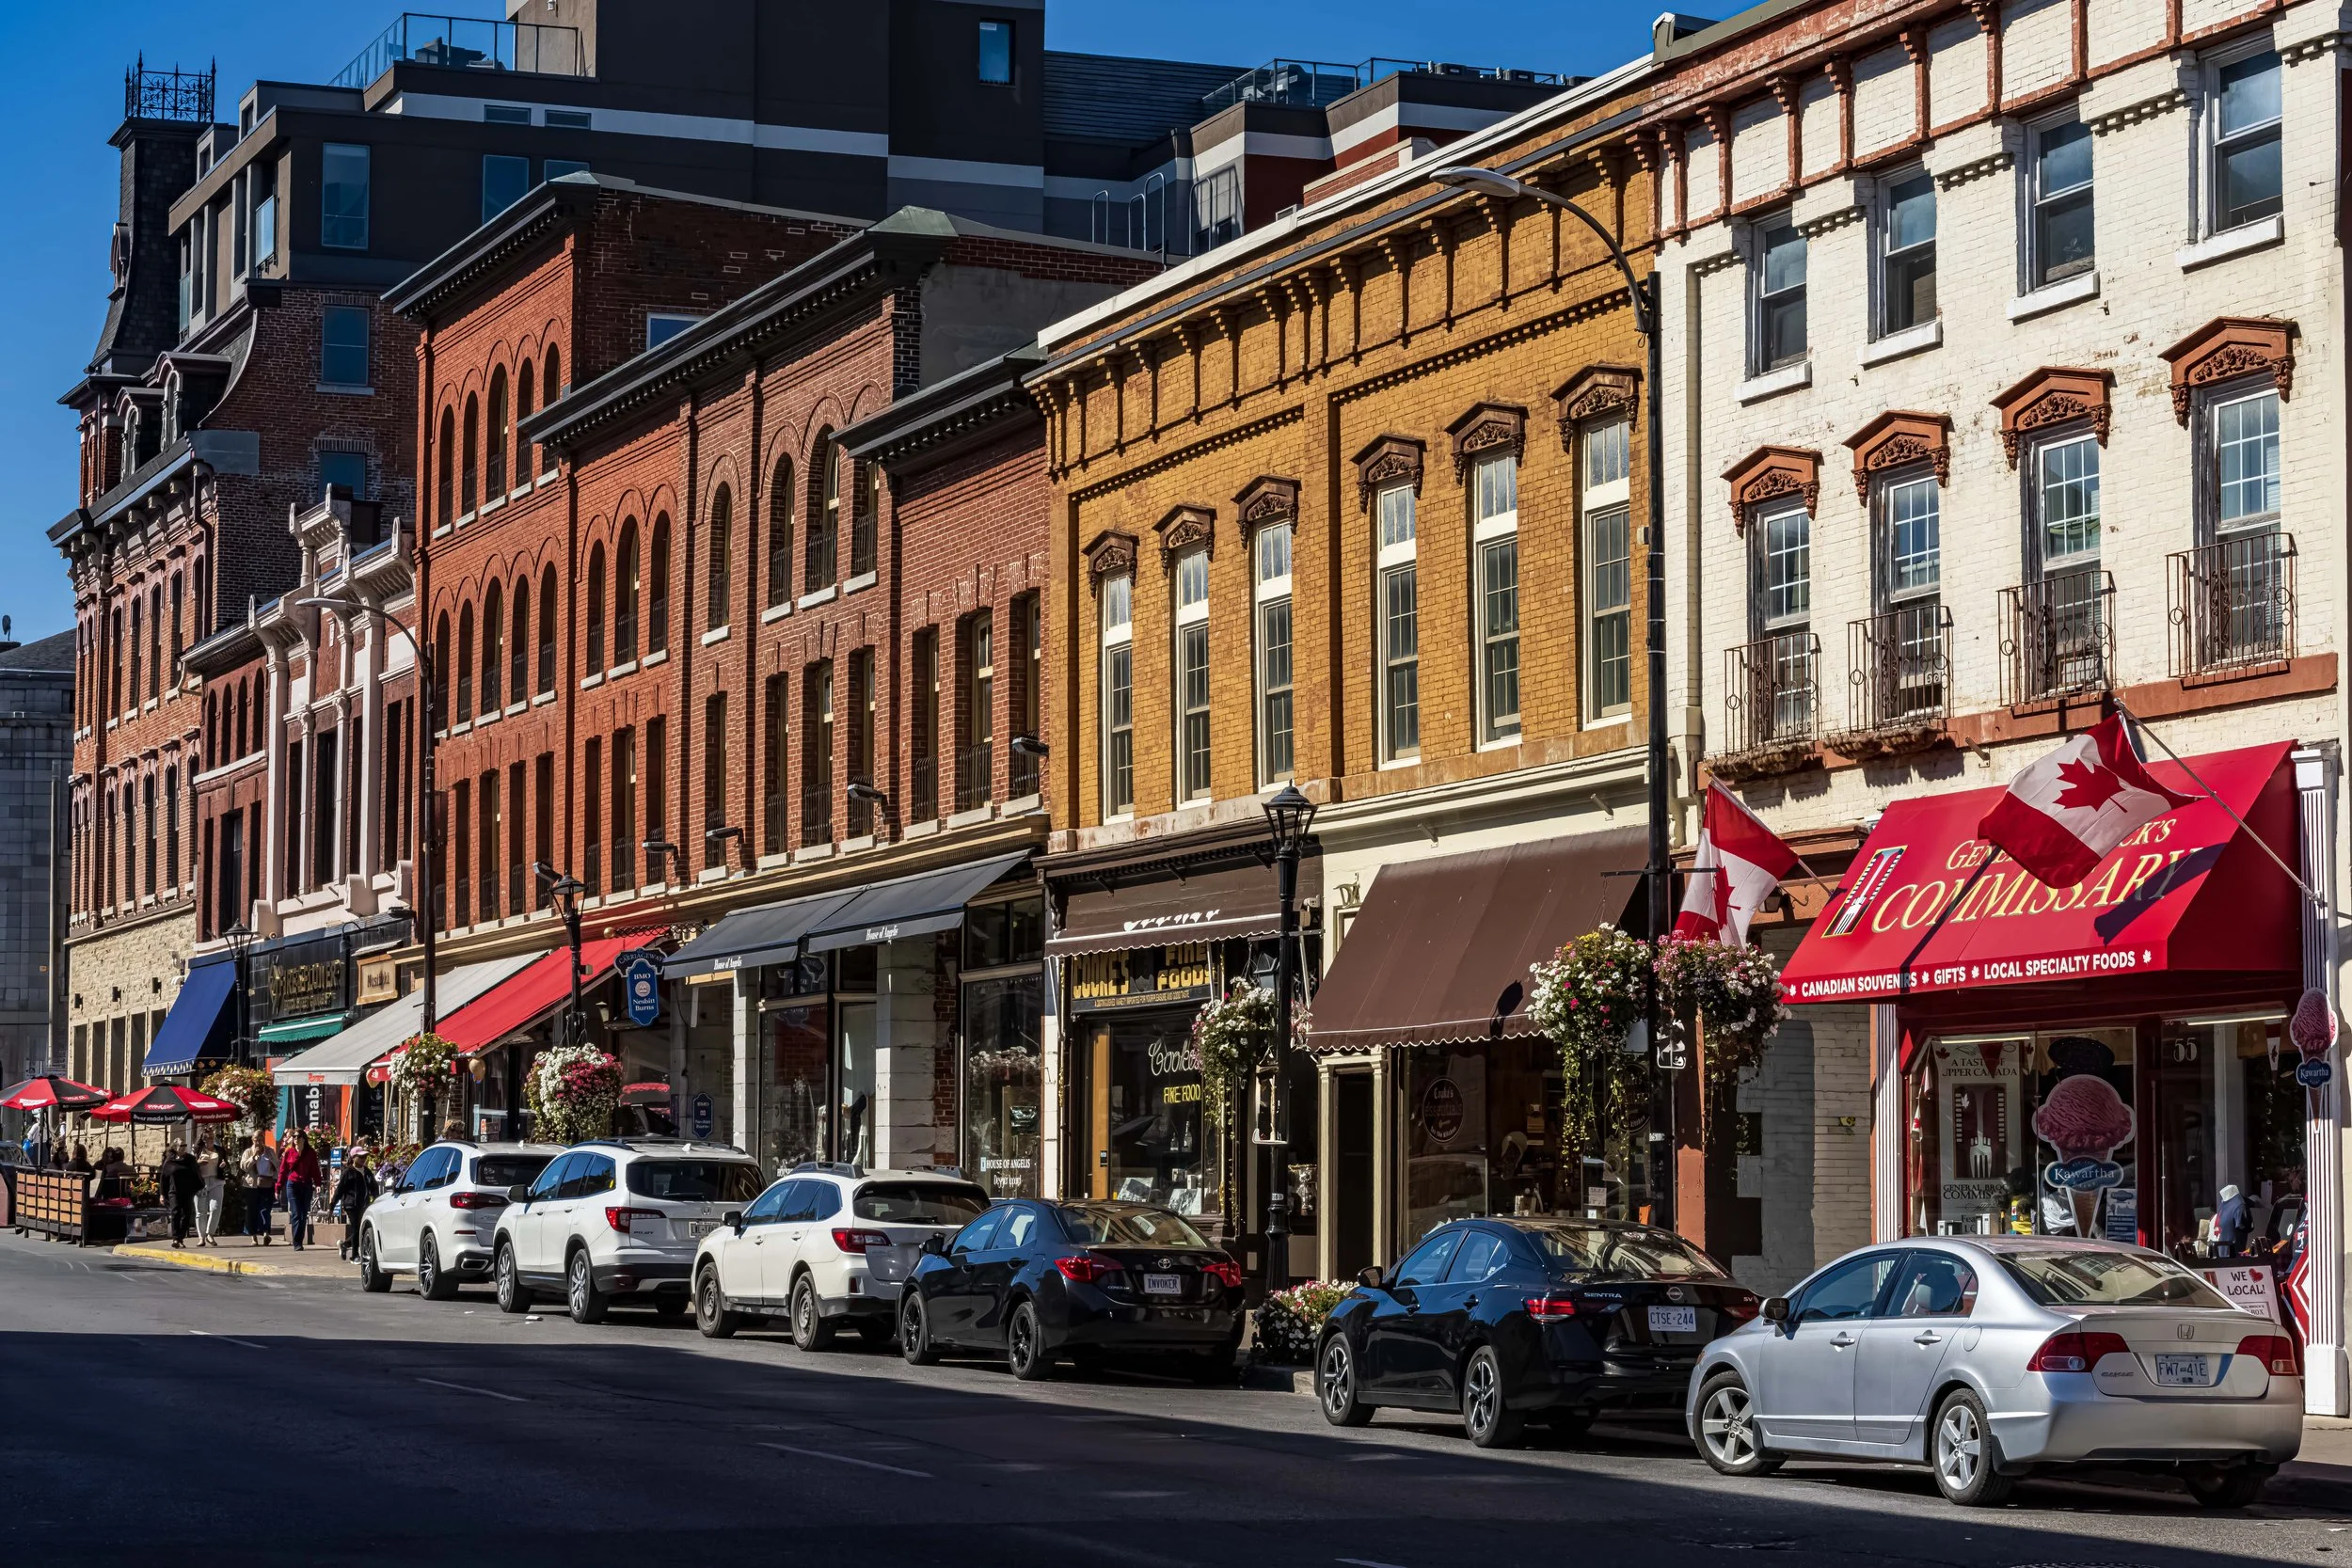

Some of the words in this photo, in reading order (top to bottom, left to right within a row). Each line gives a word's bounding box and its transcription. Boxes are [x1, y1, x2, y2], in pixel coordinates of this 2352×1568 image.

[1871, 848, 2204, 933] COMMISSARY
[866, 928, 879, 941] House
[619, 953, 662, 963] CARRIAGEWAY
[714, 958, 725, 970] House
[1073, 950, 1129, 999] COOKE'S
[1166, 942, 1207, 966] FINE
[1802, 978, 1855, 997] CANADIAN
[1857, 972, 1917, 992] SOUVENIRS
[1934, 967, 1966, 985] GIFTS
[1984, 962, 2023, 980] LOCAL
[2026, 955, 2090, 976] SPECIALTY
[2092, 951, 2136, 970] FOODS
[1157, 964, 1215, 990] FOODS
[1961, 1058, 1984, 1067] TAST
[1973, 1068, 2018, 1077] CAADA
[2299, 1067, 2329, 1080] Kawartha
[1164, 1086, 1182, 1103] FINE
[986, 1159, 1003, 1169] HOUSE
[1002, 1159, 1010, 1169] OF
[1009, 1158, 1031, 1169] ANGELIS
[2054, 1167, 2115, 1181] Kawartha
[2230, 1271, 2248, 1282] WE
[1148, 1278, 1178, 1289] INVOKER
[2227, 1285, 2266, 1296] LOCAL!
